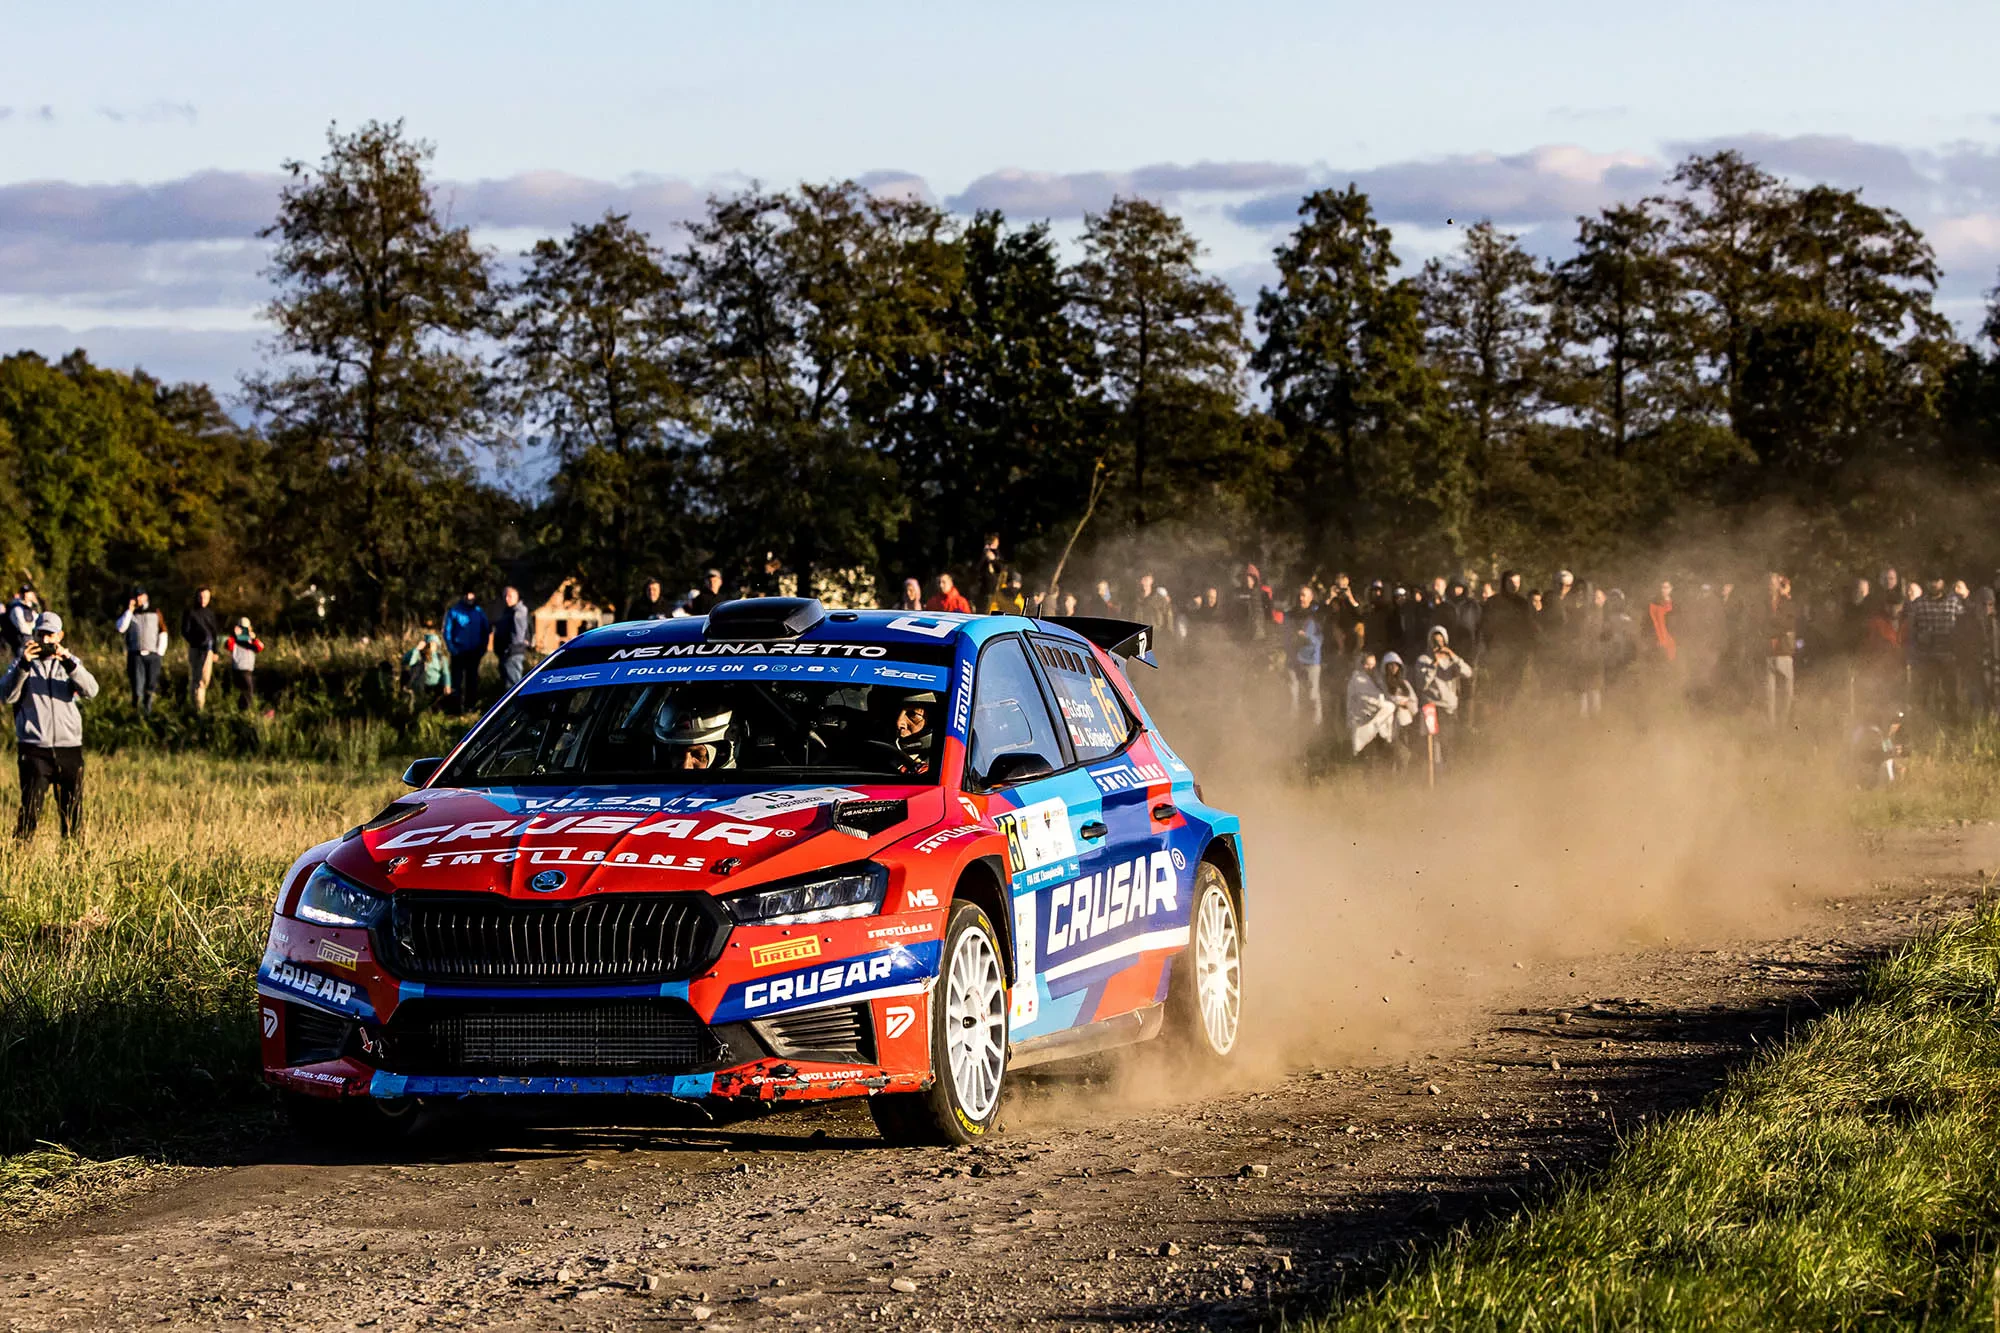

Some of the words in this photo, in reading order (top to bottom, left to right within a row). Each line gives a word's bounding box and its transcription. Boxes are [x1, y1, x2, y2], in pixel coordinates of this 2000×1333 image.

[608, 645, 664, 661] MS
[662, 643, 888, 658] MUNARETTO
[627, 665, 693, 676] FOLLOW
[695, 664, 716, 673] US
[721, 664, 745, 673] ON
[1089, 677, 1128, 744] 15
[752, 791, 795, 803] 15
[318, 940, 357, 970] PIRELLI
[752, 936, 820, 967] PIRELLI
